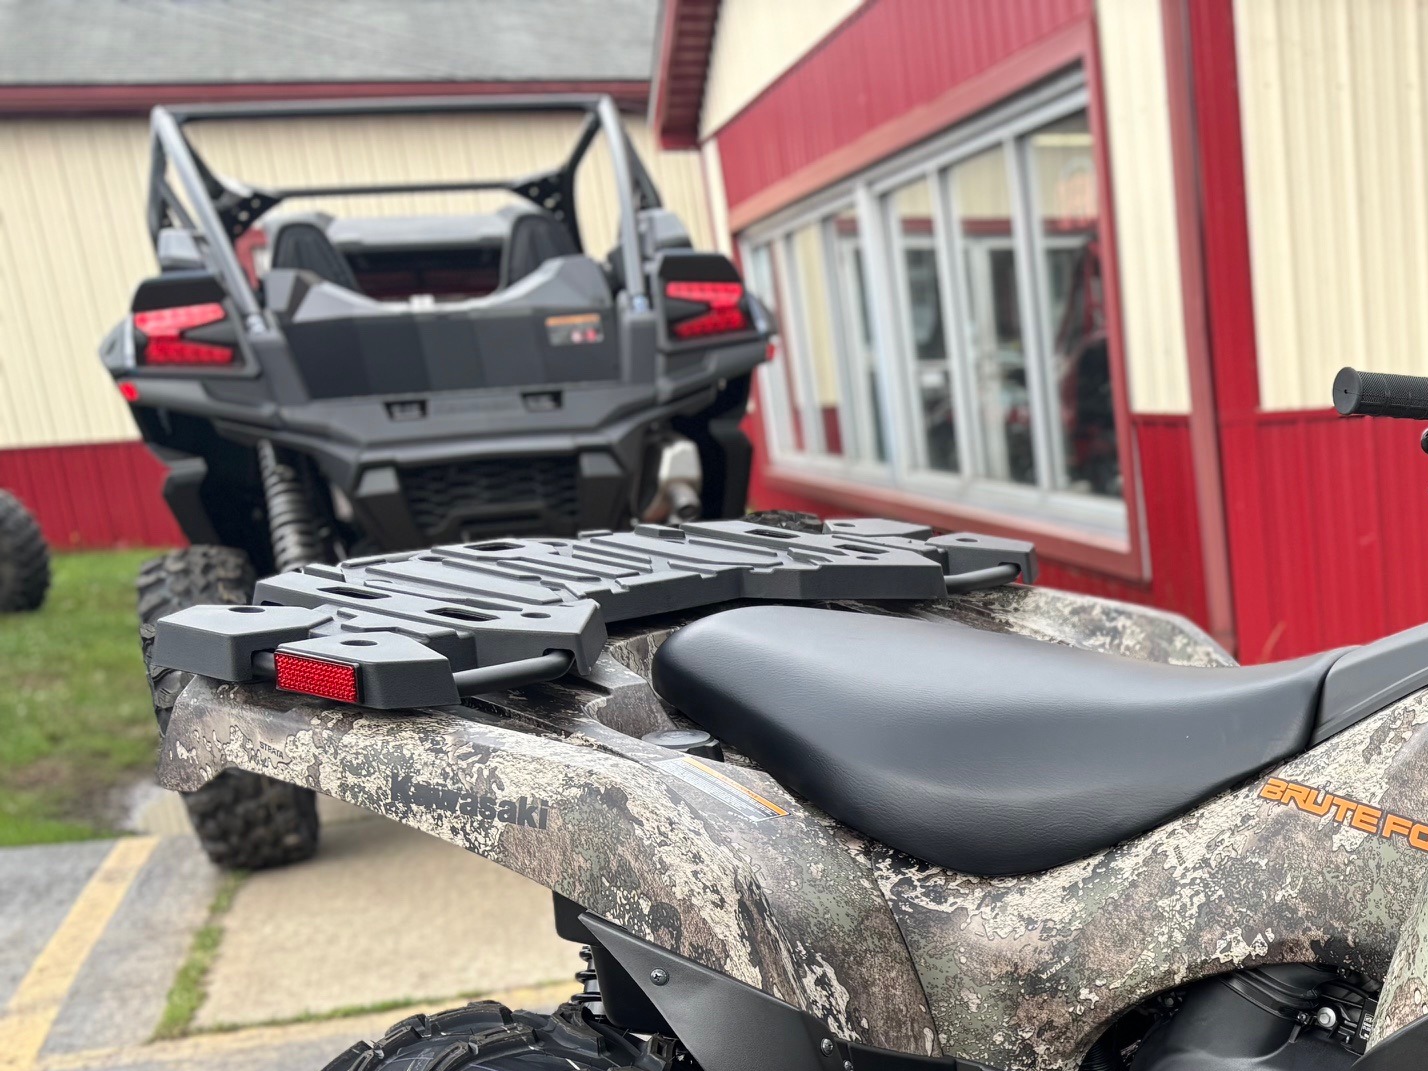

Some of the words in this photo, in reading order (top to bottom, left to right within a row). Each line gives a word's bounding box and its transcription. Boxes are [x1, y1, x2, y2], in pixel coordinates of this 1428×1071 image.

[259, 741, 284, 760] STRATA
[391, 768, 550, 830] Kawasaki
[1257, 776, 1383, 836] BRUTE
